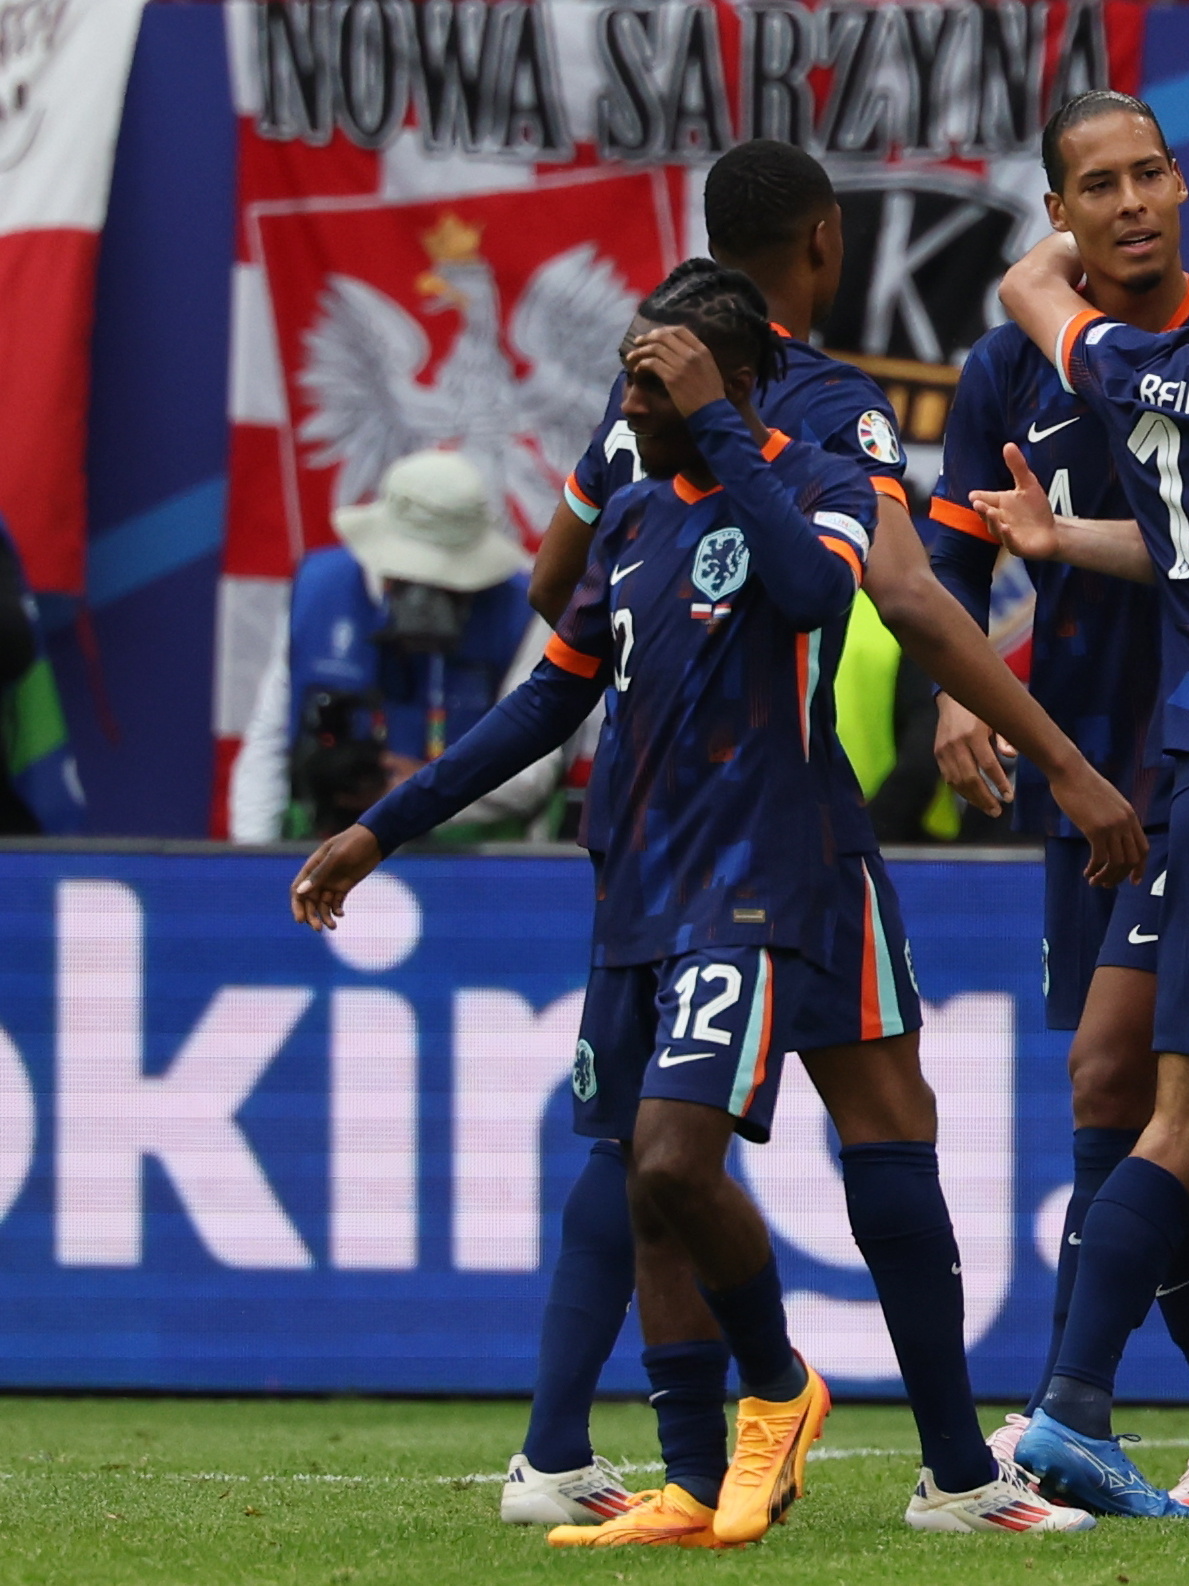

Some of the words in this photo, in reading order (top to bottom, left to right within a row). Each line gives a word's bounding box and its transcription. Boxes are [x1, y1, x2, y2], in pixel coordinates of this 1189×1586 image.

[256, 0, 576, 162] NOWA
[600, 0, 1108, 158] SARZYNA
[860, 188, 988, 364] K
[610, 607, 635, 692] 2
[671, 963, 743, 1046] 12
